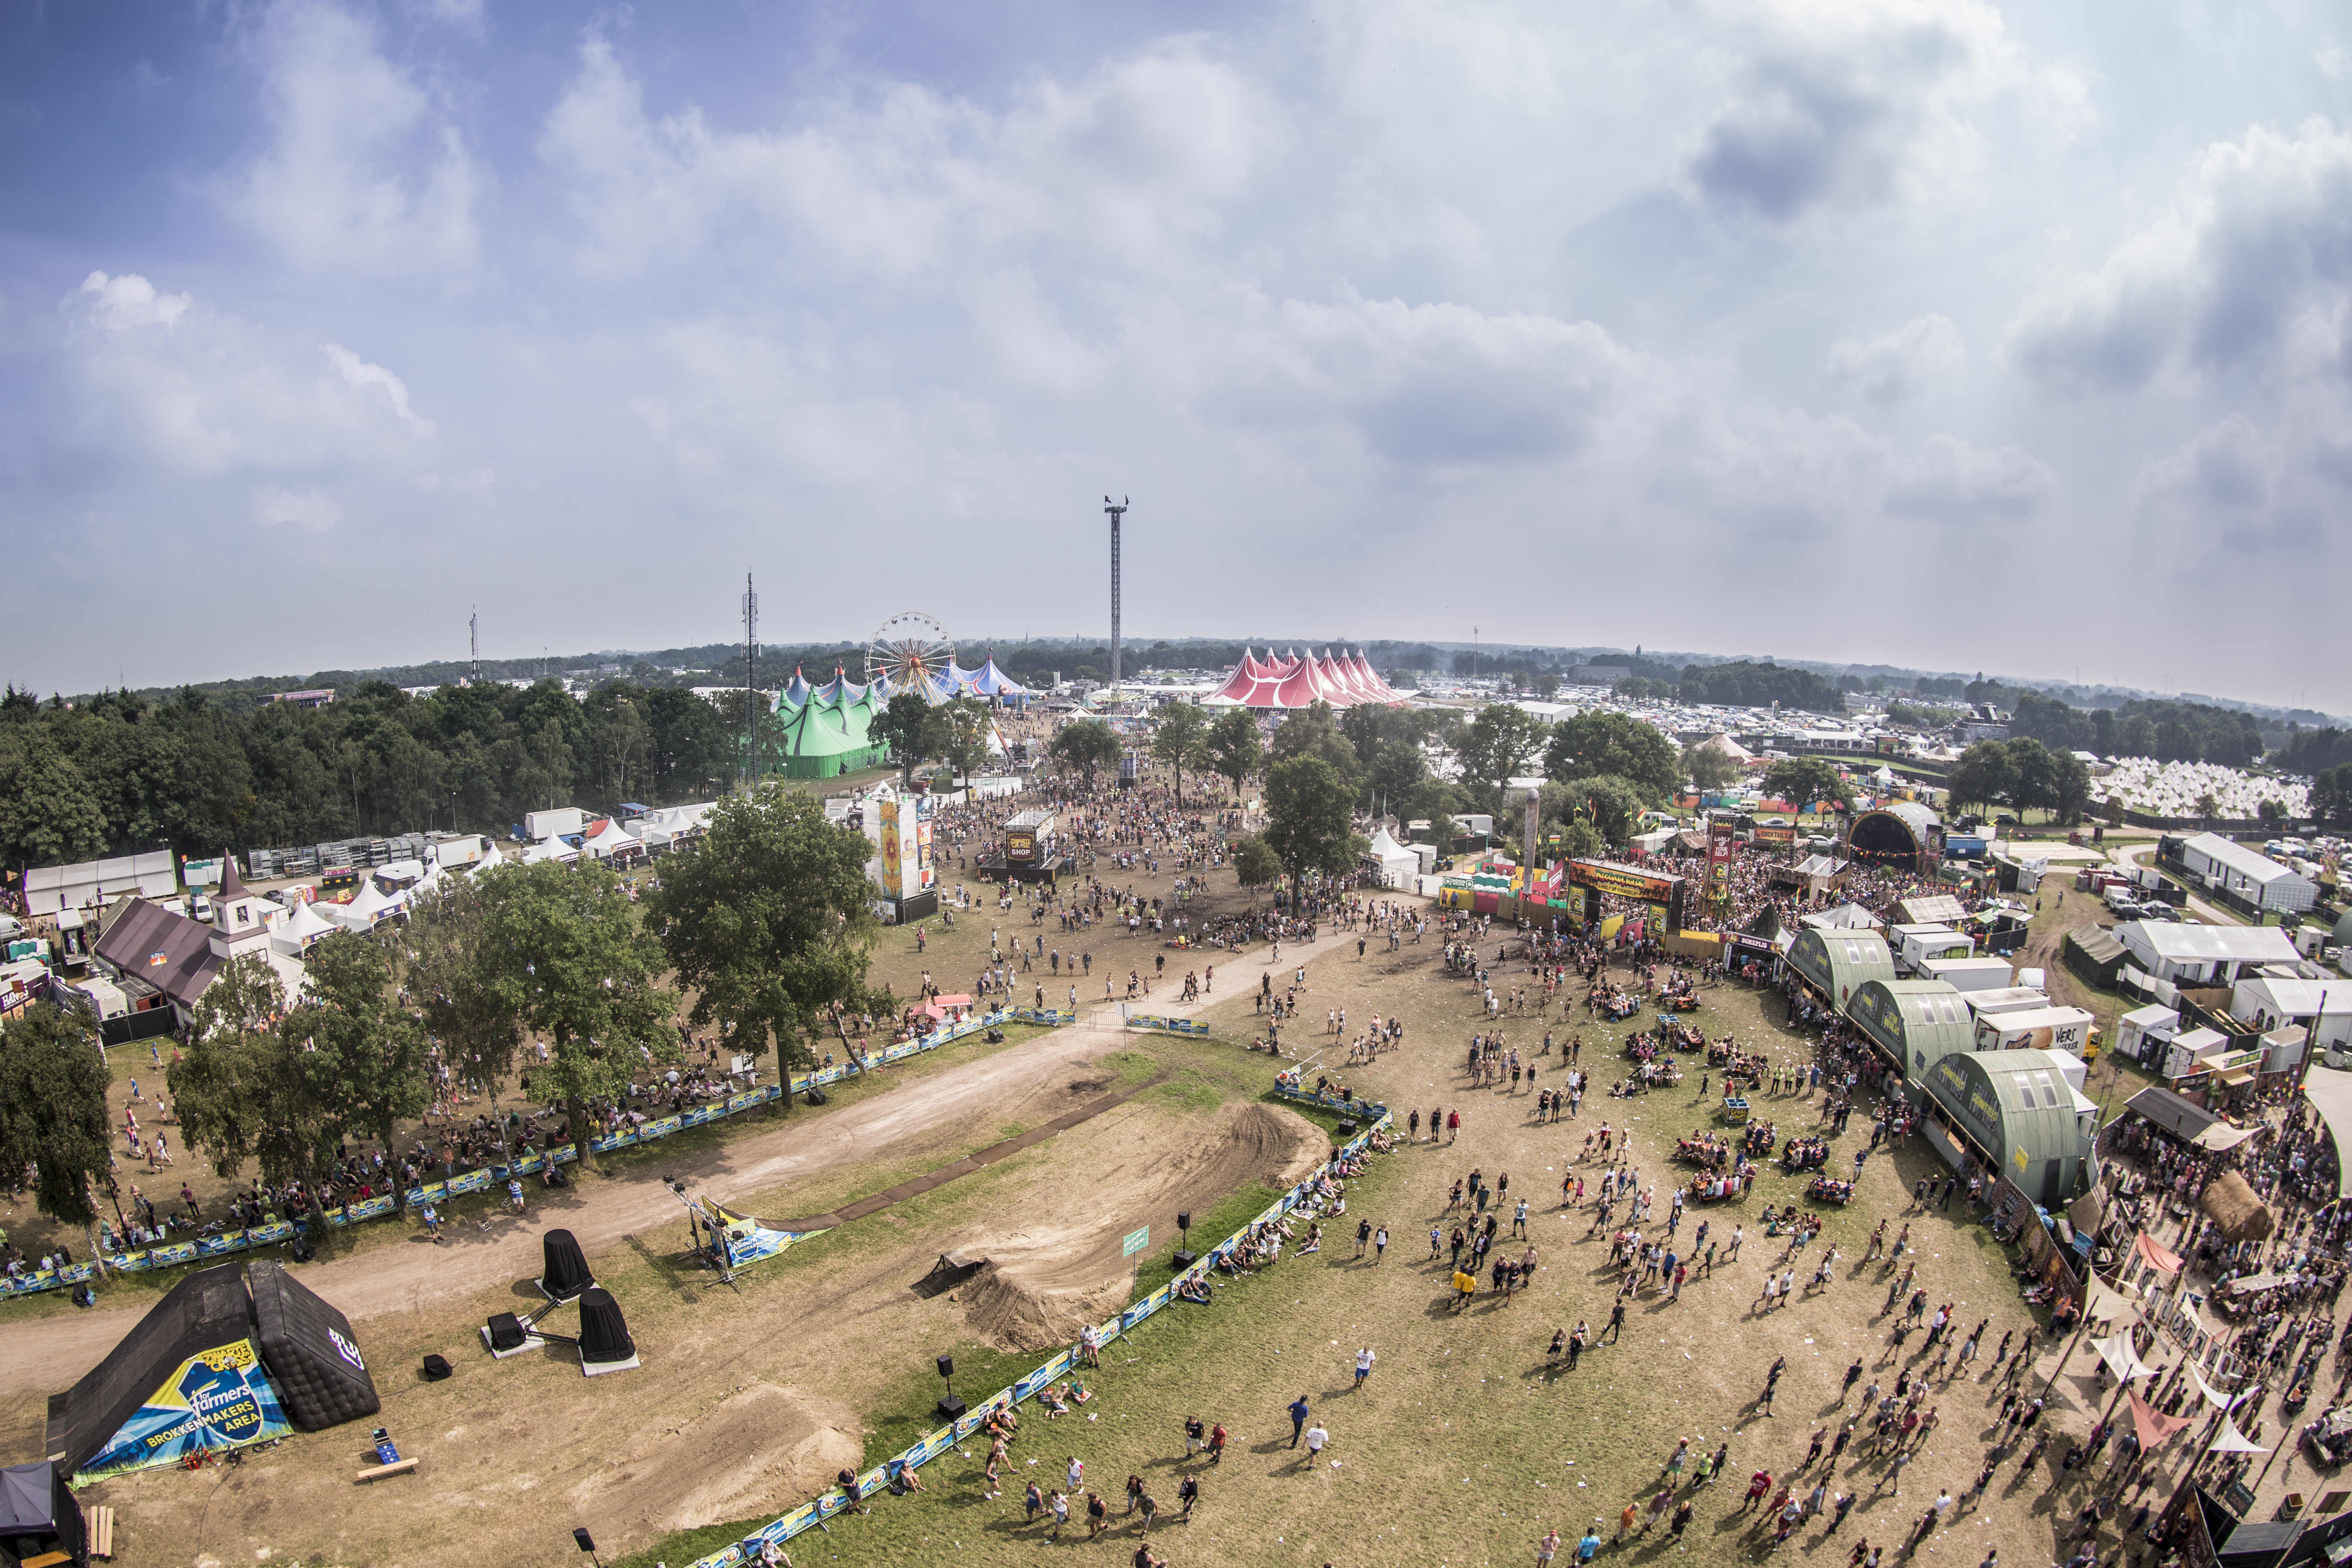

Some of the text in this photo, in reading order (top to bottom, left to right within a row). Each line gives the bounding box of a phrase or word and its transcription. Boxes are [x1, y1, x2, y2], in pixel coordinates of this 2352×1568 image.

[383, 907, 395, 916] TOSTI
[1741, 937, 1768, 948] SCHEPIJS
[2, 985, 29, 1007] HANS
[2056, 1028, 2077, 1043] VERS
[202, 1344, 250, 1366] ZWARTE
[146, 1401, 254, 1448] BROKKENMAKERS
[225, 1412, 262, 1432] AREA
